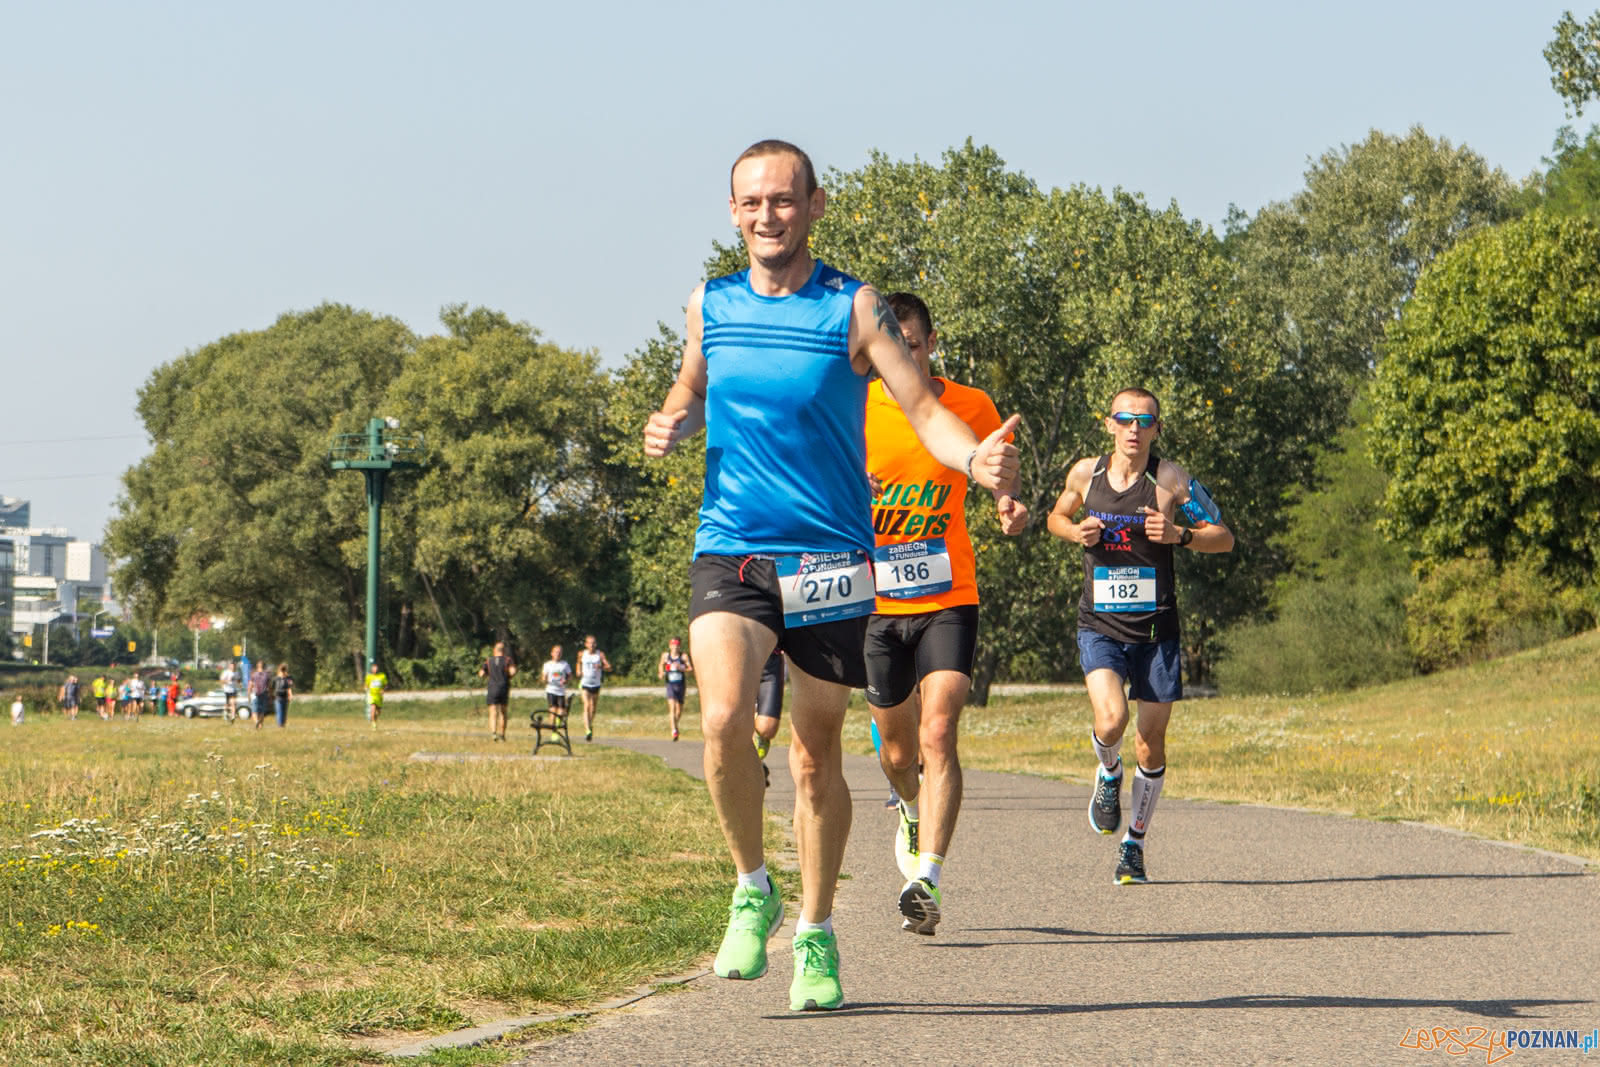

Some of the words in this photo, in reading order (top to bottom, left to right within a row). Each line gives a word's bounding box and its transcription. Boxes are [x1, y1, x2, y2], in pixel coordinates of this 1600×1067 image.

[873, 508, 951, 537] UZers
[1104, 543, 1132, 553] TEAM
[891, 562, 930, 584] 186
[804, 575, 852, 604] 270
[1108, 584, 1139, 599] 182
